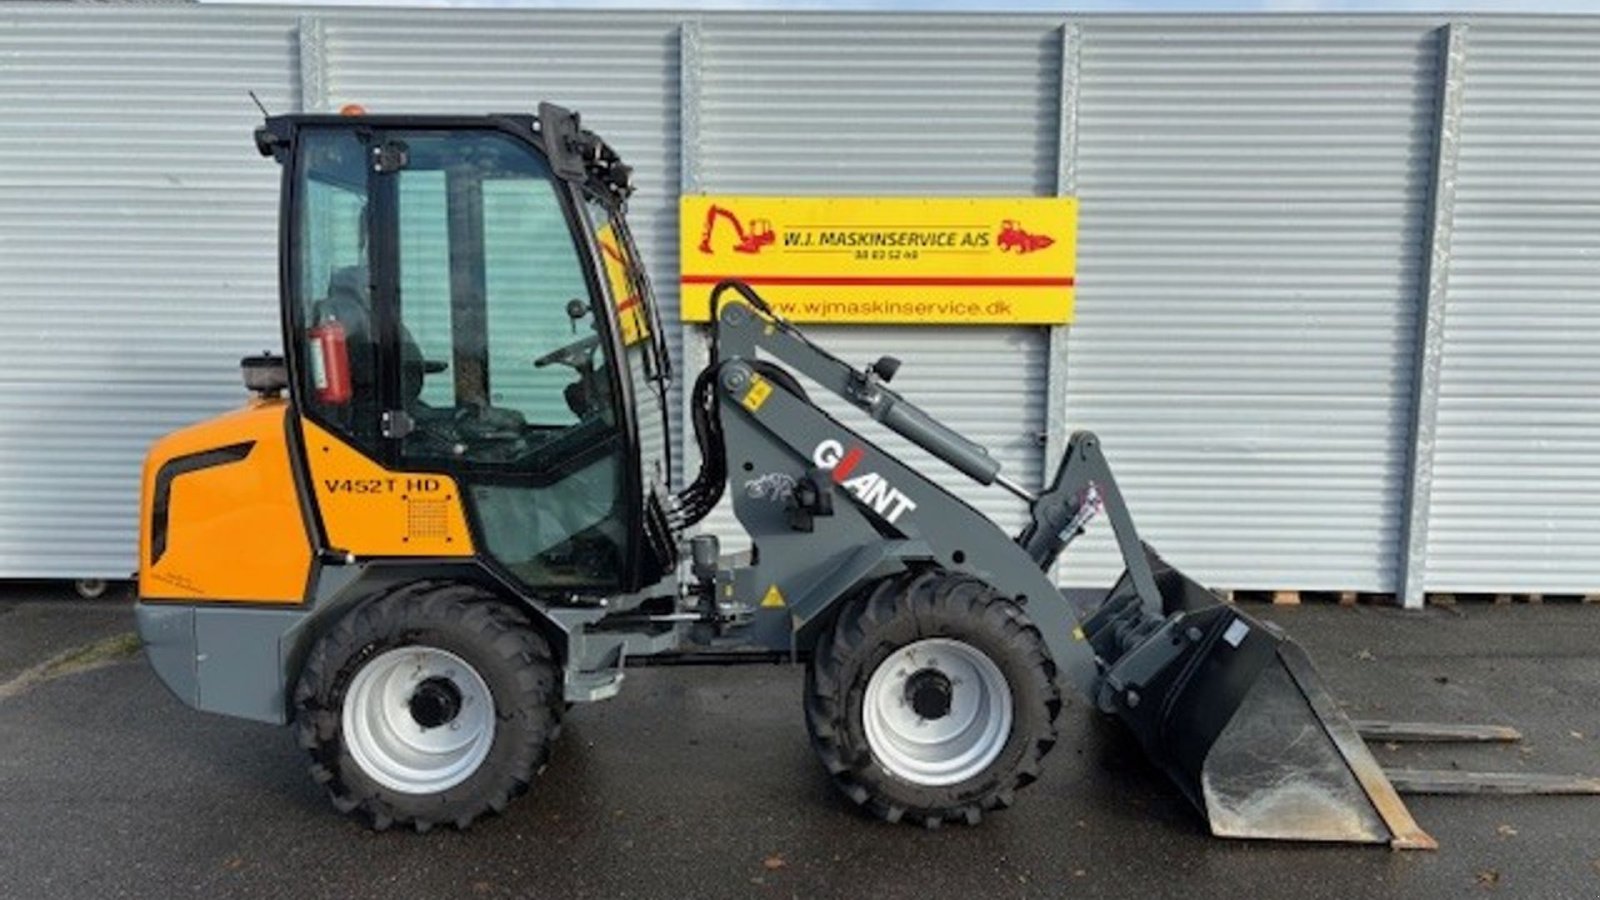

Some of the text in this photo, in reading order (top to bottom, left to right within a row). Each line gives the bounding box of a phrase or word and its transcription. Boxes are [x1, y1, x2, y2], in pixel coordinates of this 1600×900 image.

[819, 231, 956, 247] MASKINSERVICE
[960, 231, 990, 247] A/S
[746, 298, 1012, 317] ww.wjmaskinservice.dk
[324, 478, 440, 494] V452T HD
[813, 439, 917, 524] GIANT
